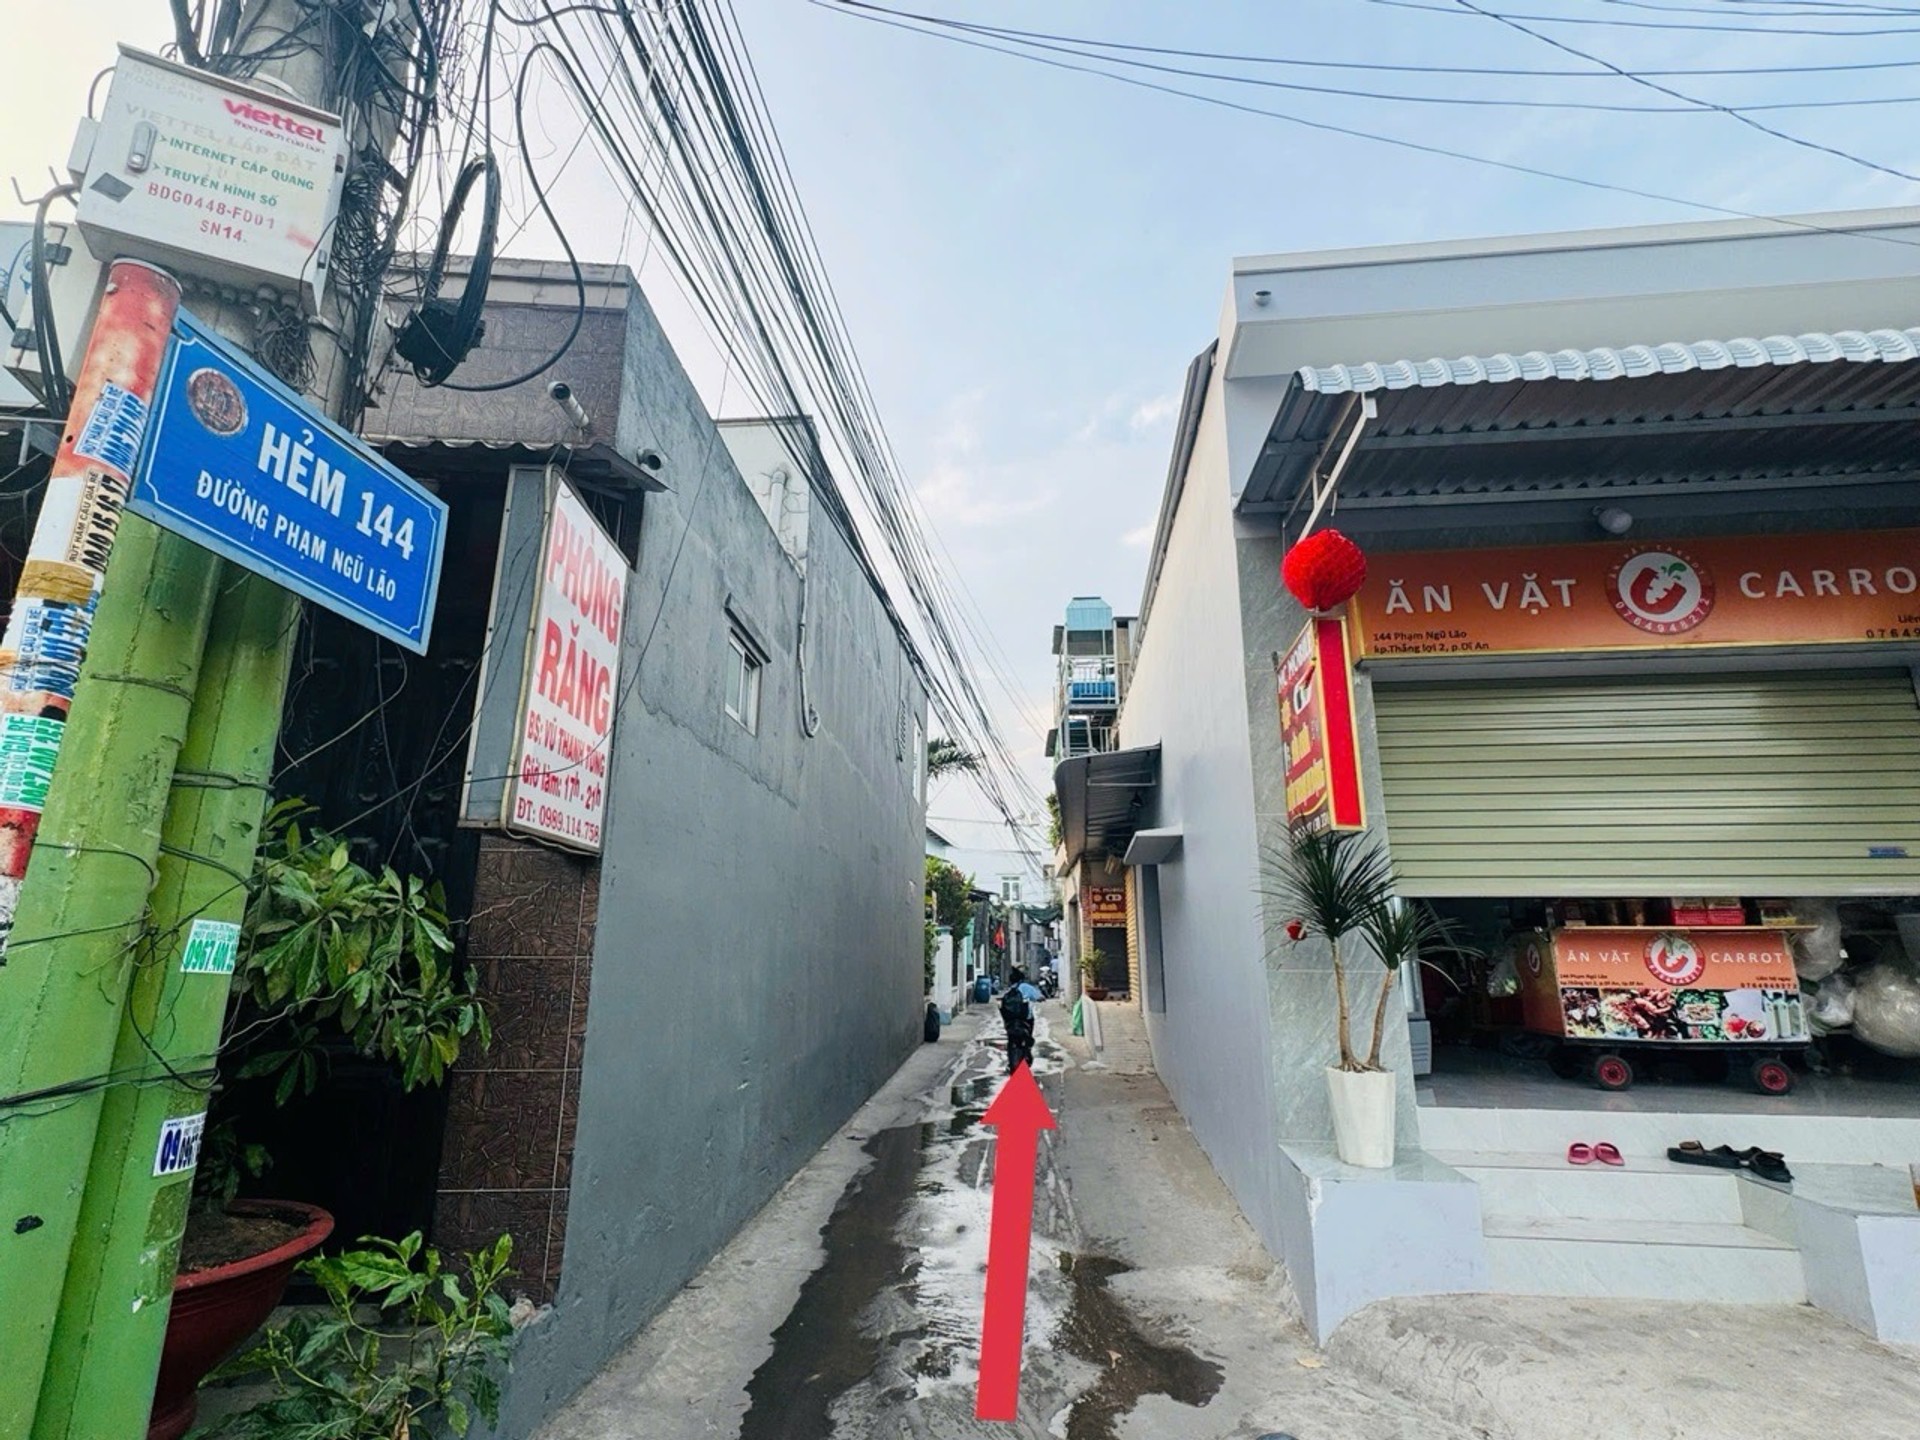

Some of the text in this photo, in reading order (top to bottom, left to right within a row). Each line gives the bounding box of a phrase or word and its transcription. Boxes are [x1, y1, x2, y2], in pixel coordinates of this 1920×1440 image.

[170, 137, 237, 166] INTERNET
[270, 169, 316, 191] QUANG
[222, 182, 256, 202] HÌNH
[259, 192, 280, 208] SỐ
[258, 422, 415, 560] HẺM 144
[195, 468, 397, 602] ĐƯỜNG PHẠM NGŨ LÃO
[548, 506, 622, 647] PHÒNG
[1385, 579, 1452, 615] ĂN
[1481, 572, 1577, 615] VẶT
[1373, 629, 1467, 641] 144 Phạm Ngũ Lão
[1475, 641, 1489, 650] An
[537, 617, 612, 737] RĂNG
[526, 709, 544, 744] BS:
[558, 728, 584, 765] THANH
[522, 753, 541, 789] Giờ
[517, 796, 537, 823] ĐT:
[1566, 949, 1784, 965] ĂN VẶT CARROT
